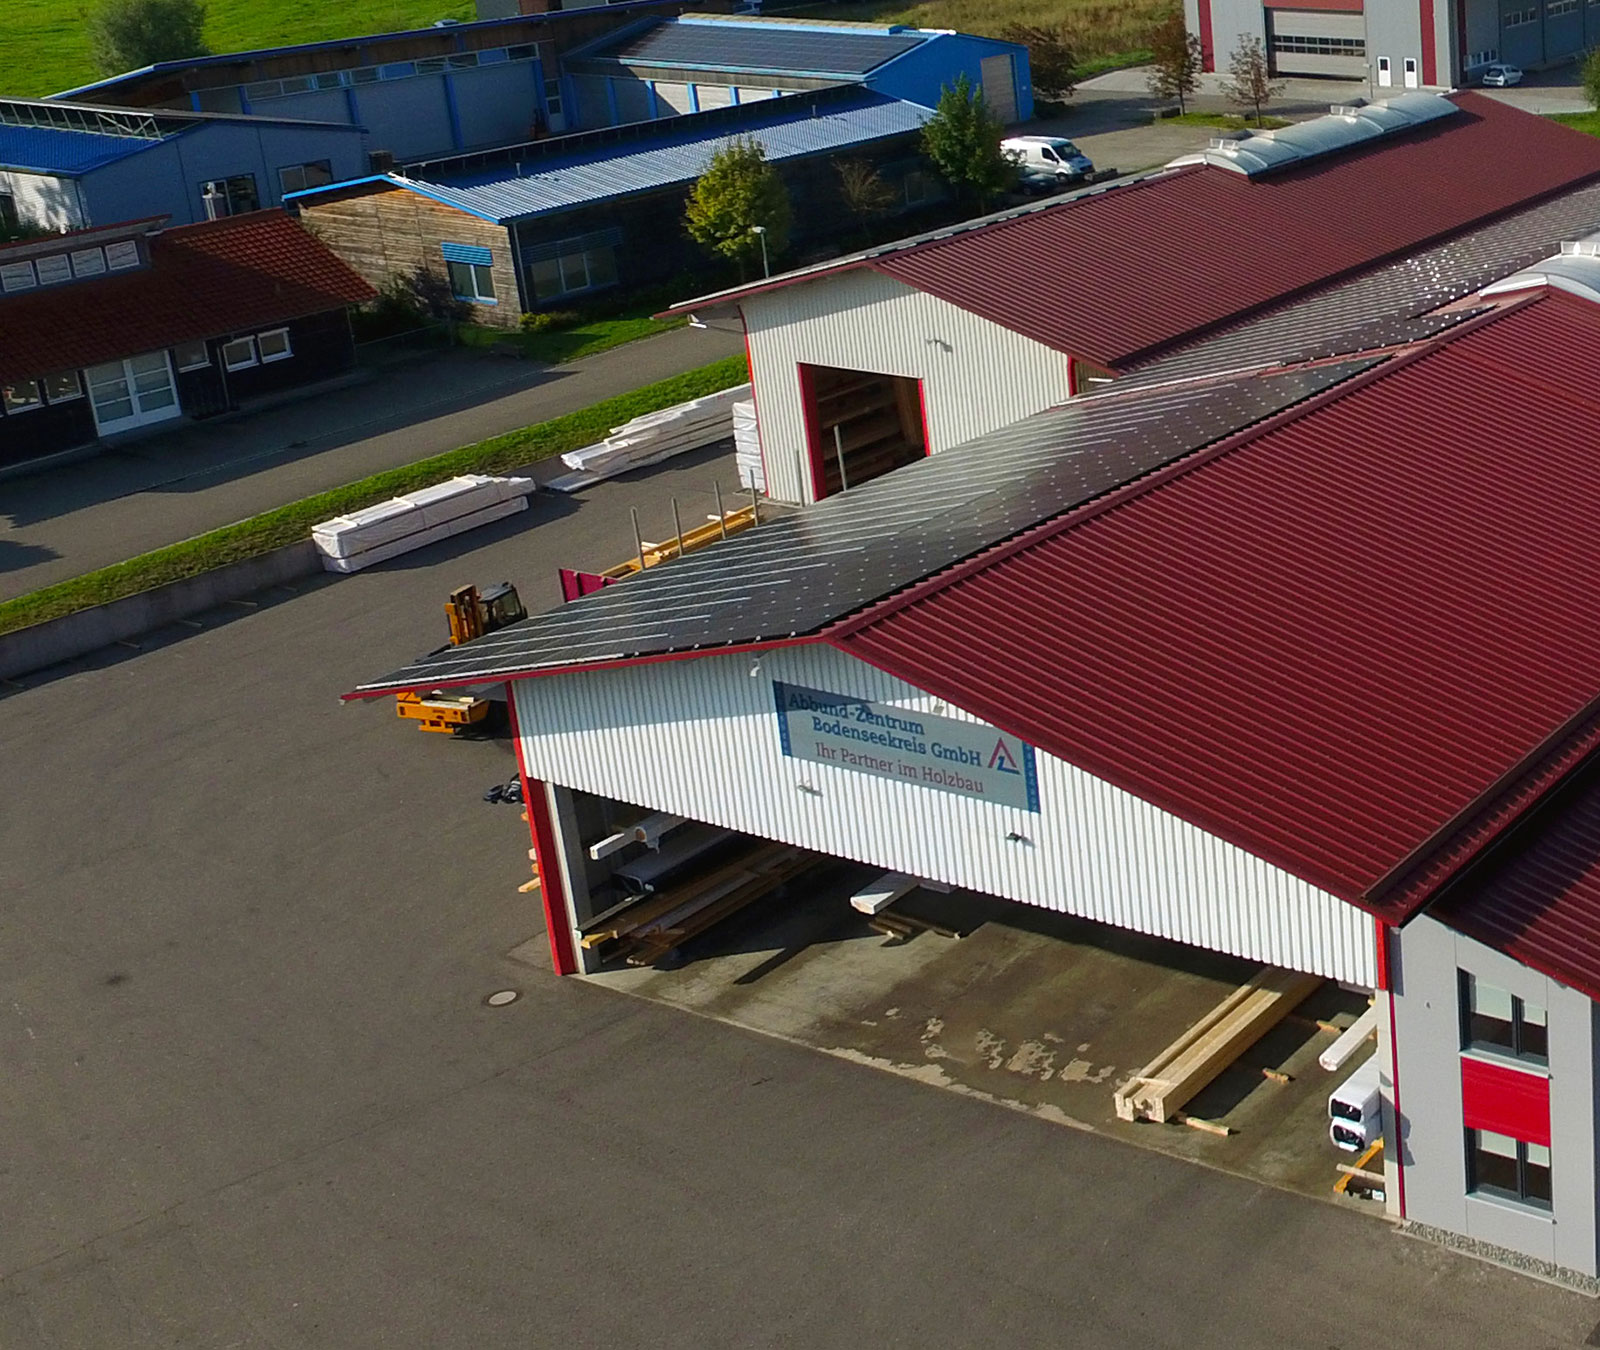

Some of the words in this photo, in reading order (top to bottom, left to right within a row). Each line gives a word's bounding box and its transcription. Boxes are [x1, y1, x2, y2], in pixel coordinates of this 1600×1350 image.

[790, 693, 925, 735] Abbund-Zentrum
[812, 716, 927, 754] Bodenseekreis
[931, 742, 982, 767] GmbH
[815, 742, 837, 760] Ihr
[840, 747, 893, 774] Partner
[898, 760, 918, 779] im
[921, 766, 984, 793] Holzbau
